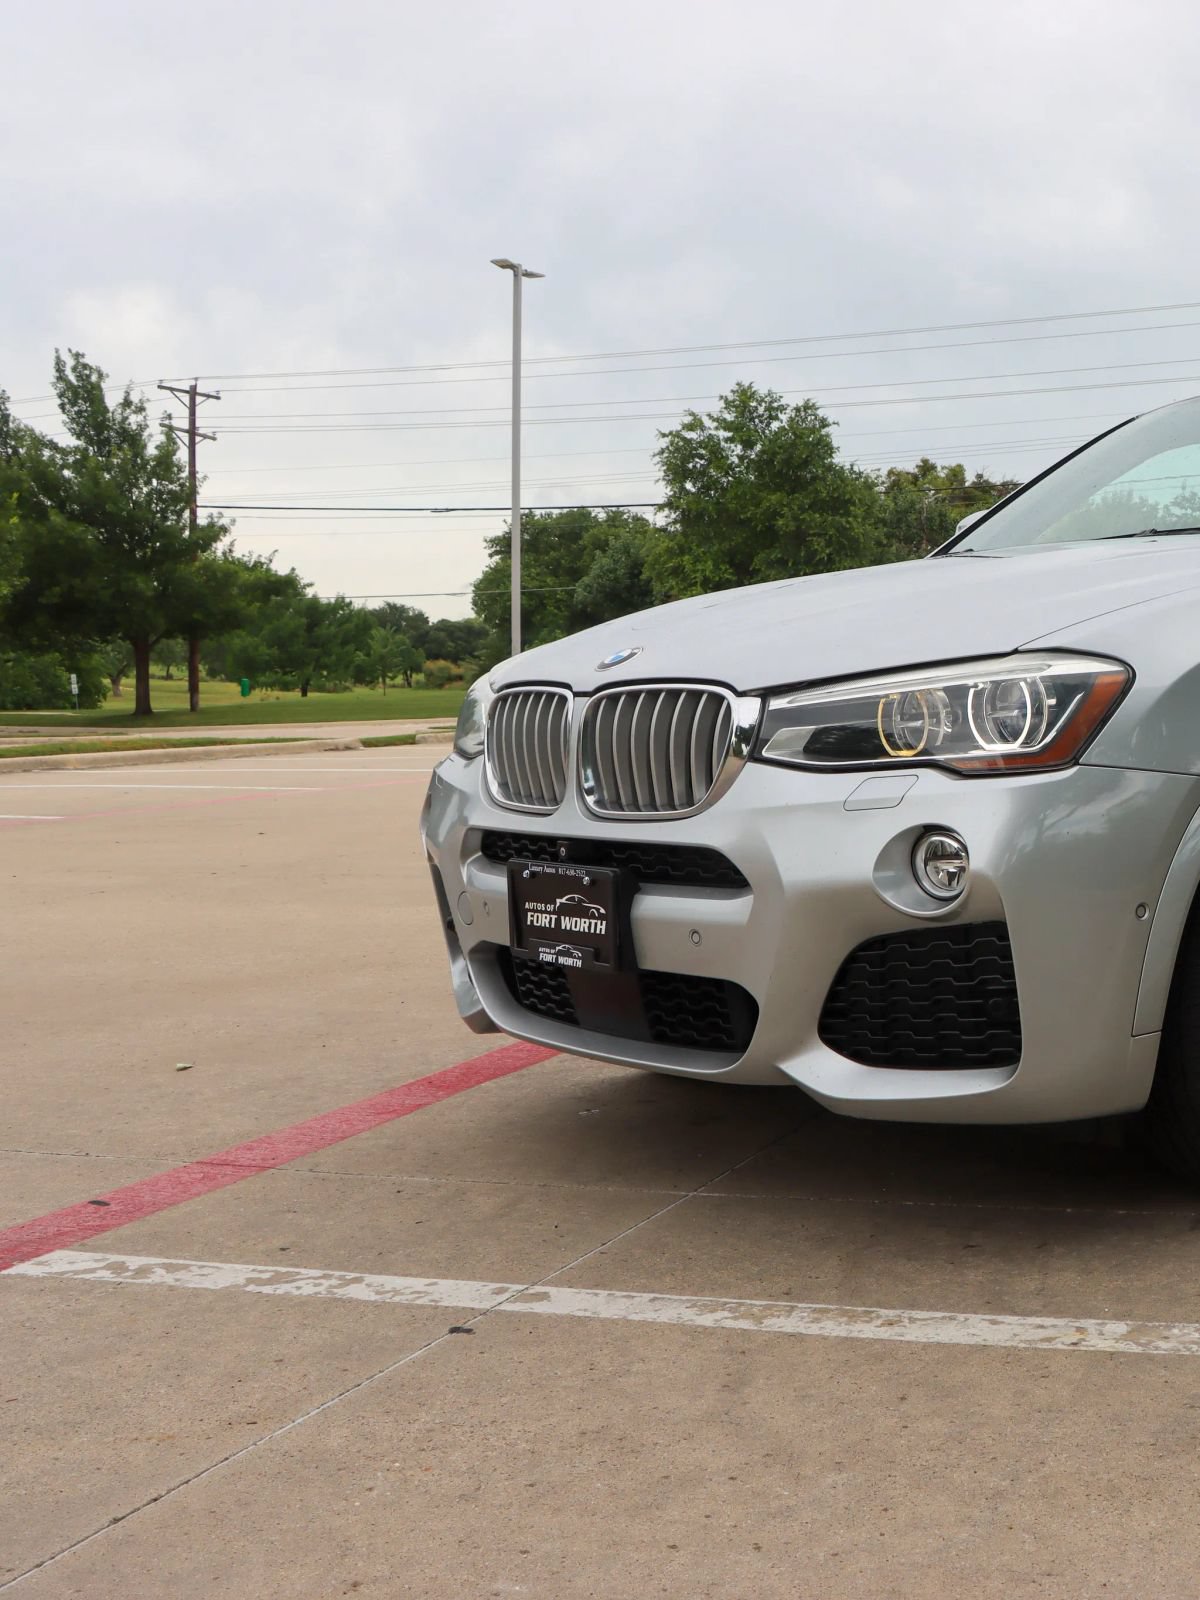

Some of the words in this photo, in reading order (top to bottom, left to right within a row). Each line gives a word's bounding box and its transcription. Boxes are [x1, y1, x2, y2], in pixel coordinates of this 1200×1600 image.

[525, 902, 545, 911] AUTOS
[527, 912, 557, 928] FORT
[560, 916, 606, 934] WORTH
[540, 953, 556, 963] FORT
[558, 956, 582, 968] WORTH
